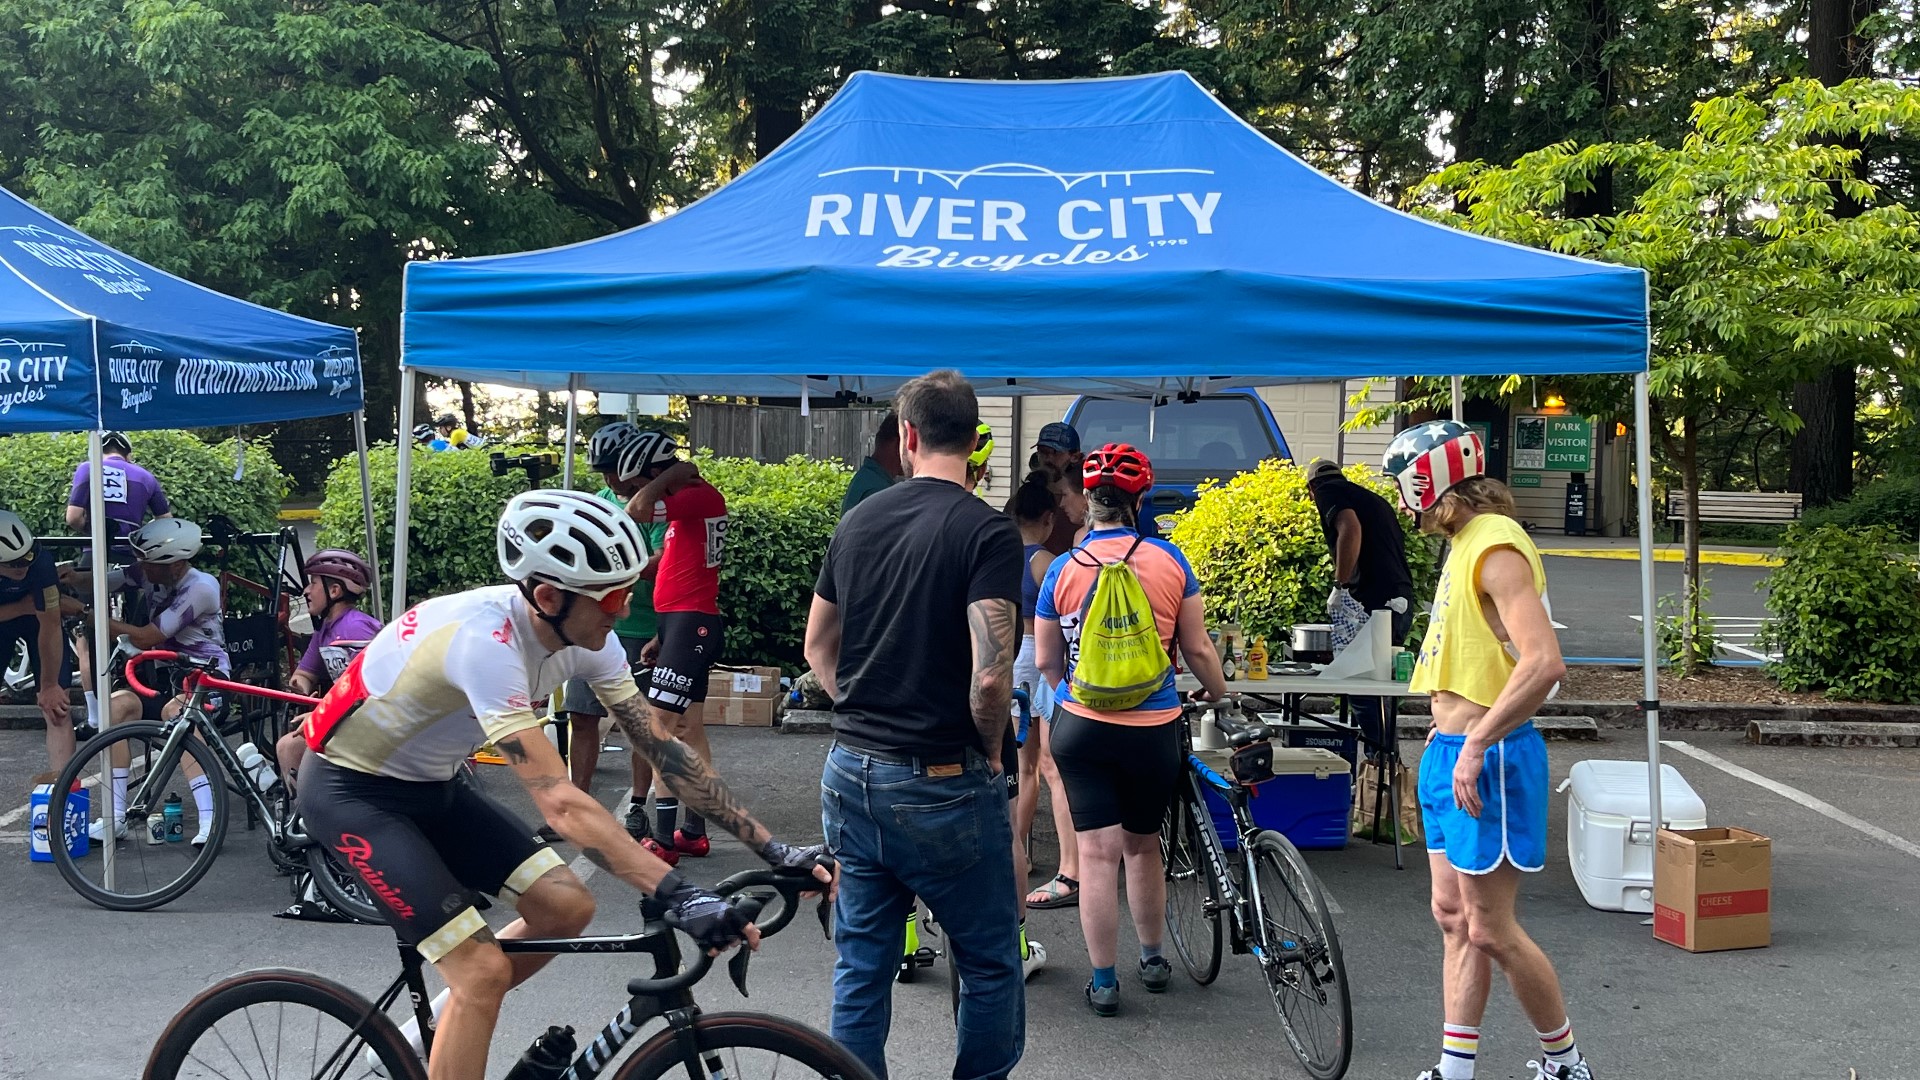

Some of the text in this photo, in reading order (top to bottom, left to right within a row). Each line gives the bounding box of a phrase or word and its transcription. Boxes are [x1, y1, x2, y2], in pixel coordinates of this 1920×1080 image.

[804, 192, 1222, 241] RIVER CITY
[876, 238, 1188, 271] Bicycles 1995
[18, 356, 68, 383] CITY
[109, 358, 163, 383] RIVER CITY
[175, 358, 318, 395] RIVERCITYBICYCLES.COM
[0, 384, 46, 414] ycles
[121, 385, 153, 413] Bicycles
[1554, 422, 1581, 431] PARK
[1547, 438, 1587, 447] VISITOR
[1547, 453, 1586, 462] CENTER
[501, 520, 524, 547] POC
[606, 545, 632, 571] POC
[242, 639, 254, 651] OR
[1089, 698, 1115, 708] JULY
[1305, 737, 1344, 747] ALPENROSE
[63, 801, 75, 831] TIRE
[1190, 801, 1233, 899] Bianchi
[334, 833, 415, 920] Rainier
[1657, 906, 1681, 922] CHEESE
[1700, 896, 1733, 907] CHEESE
